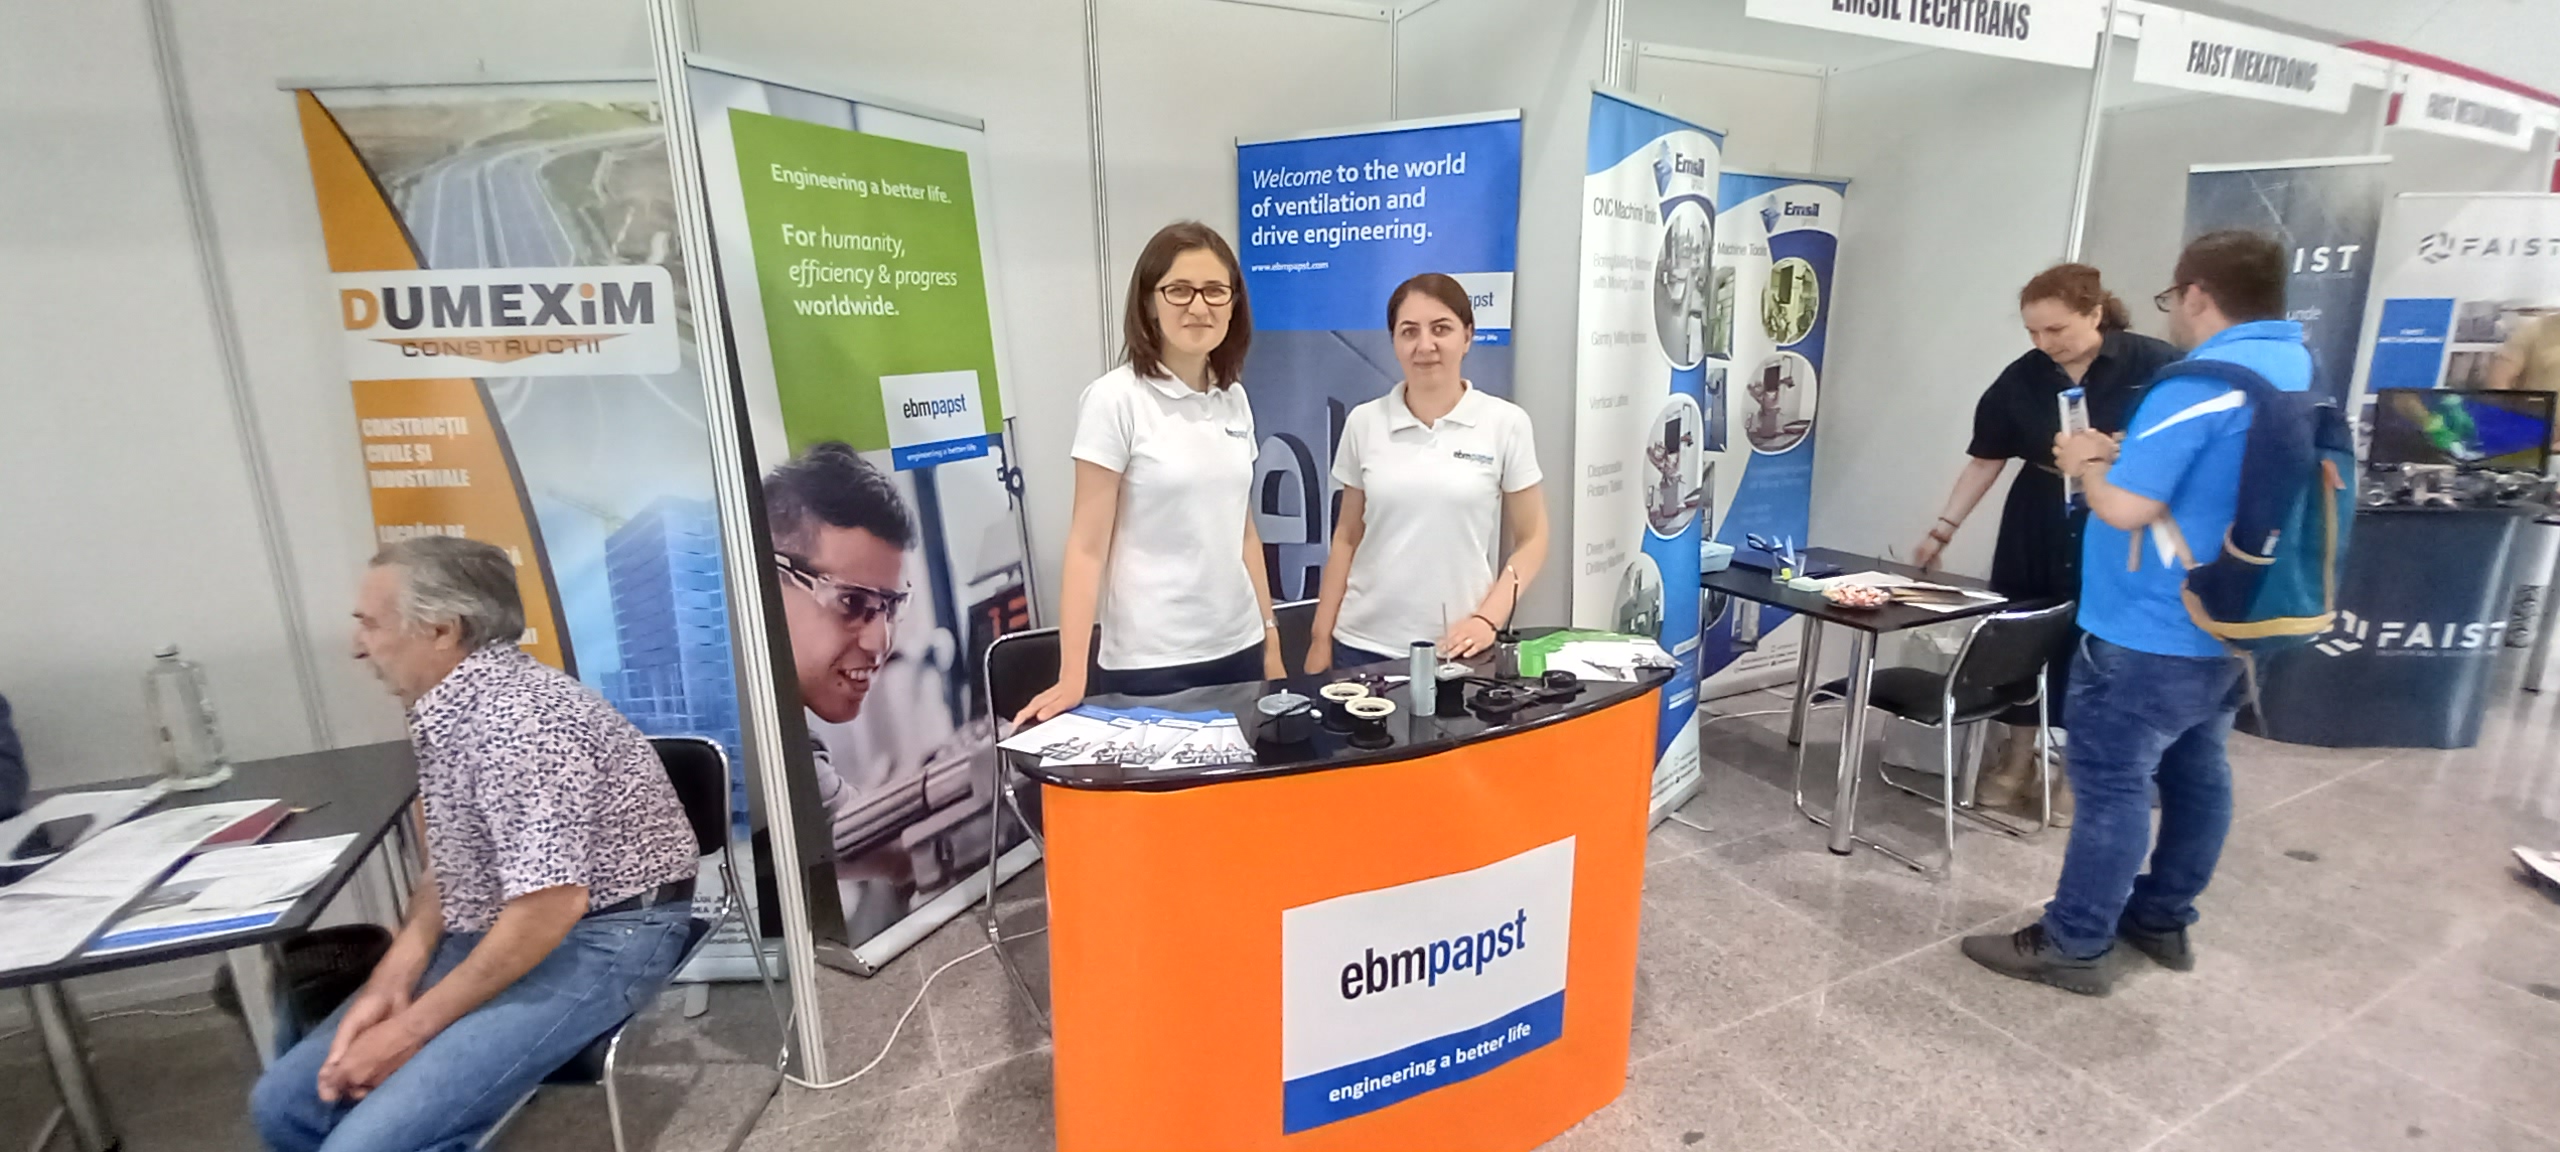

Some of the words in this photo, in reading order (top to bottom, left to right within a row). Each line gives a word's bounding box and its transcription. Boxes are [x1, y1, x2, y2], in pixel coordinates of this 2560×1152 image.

[2186, 40, 2233, 78] FAIST
[1252, 167, 1332, 190] Welcome
[1336, 164, 1358, 183] to
[1363, 159, 1399, 181] the
[1404, 152, 1466, 178] world
[1675, 152, 1706, 178] Emsil
[771, 163, 868, 198] Engineering
[870, 181, 880, 195] a
[881, 178, 925, 200] better
[927, 184, 952, 204] life.
[1251, 195, 1271, 218] of
[1275, 191, 1381, 217] ventilation
[1386, 186, 1426, 209] and
[1614, 200, 1643, 222] Machine
[1784, 201, 1821, 217] Emsil
[781, 223, 816, 247] For
[821, 225, 906, 257] humanity,
[1251, 227, 1299, 246] drive
[1304, 219, 1433, 248] engineering.
[2460, 237, 2560, 257] FAIST
[1251, 261, 1329, 273] www.ebmpapst.com
[2292, 244, 2361, 274] IST
[789, 258, 874, 289] efficiency
[878, 264, 891, 285] &
[895, 266, 958, 291] progress
[794, 294, 900, 316] worldwide.
[401, 338, 600, 358] CONSTRUCTII
[903, 393, 967, 420] ebmpapst
[2377, 620, 2508, 648] FAIST
[1340, 907, 1527, 1001] ebmpapst
[1328, 1056, 1437, 1102] engineering
[1440, 1055, 1451, 1069] a
[1455, 1033, 1505, 1064] better
[1507, 1022, 1531, 1044] life
